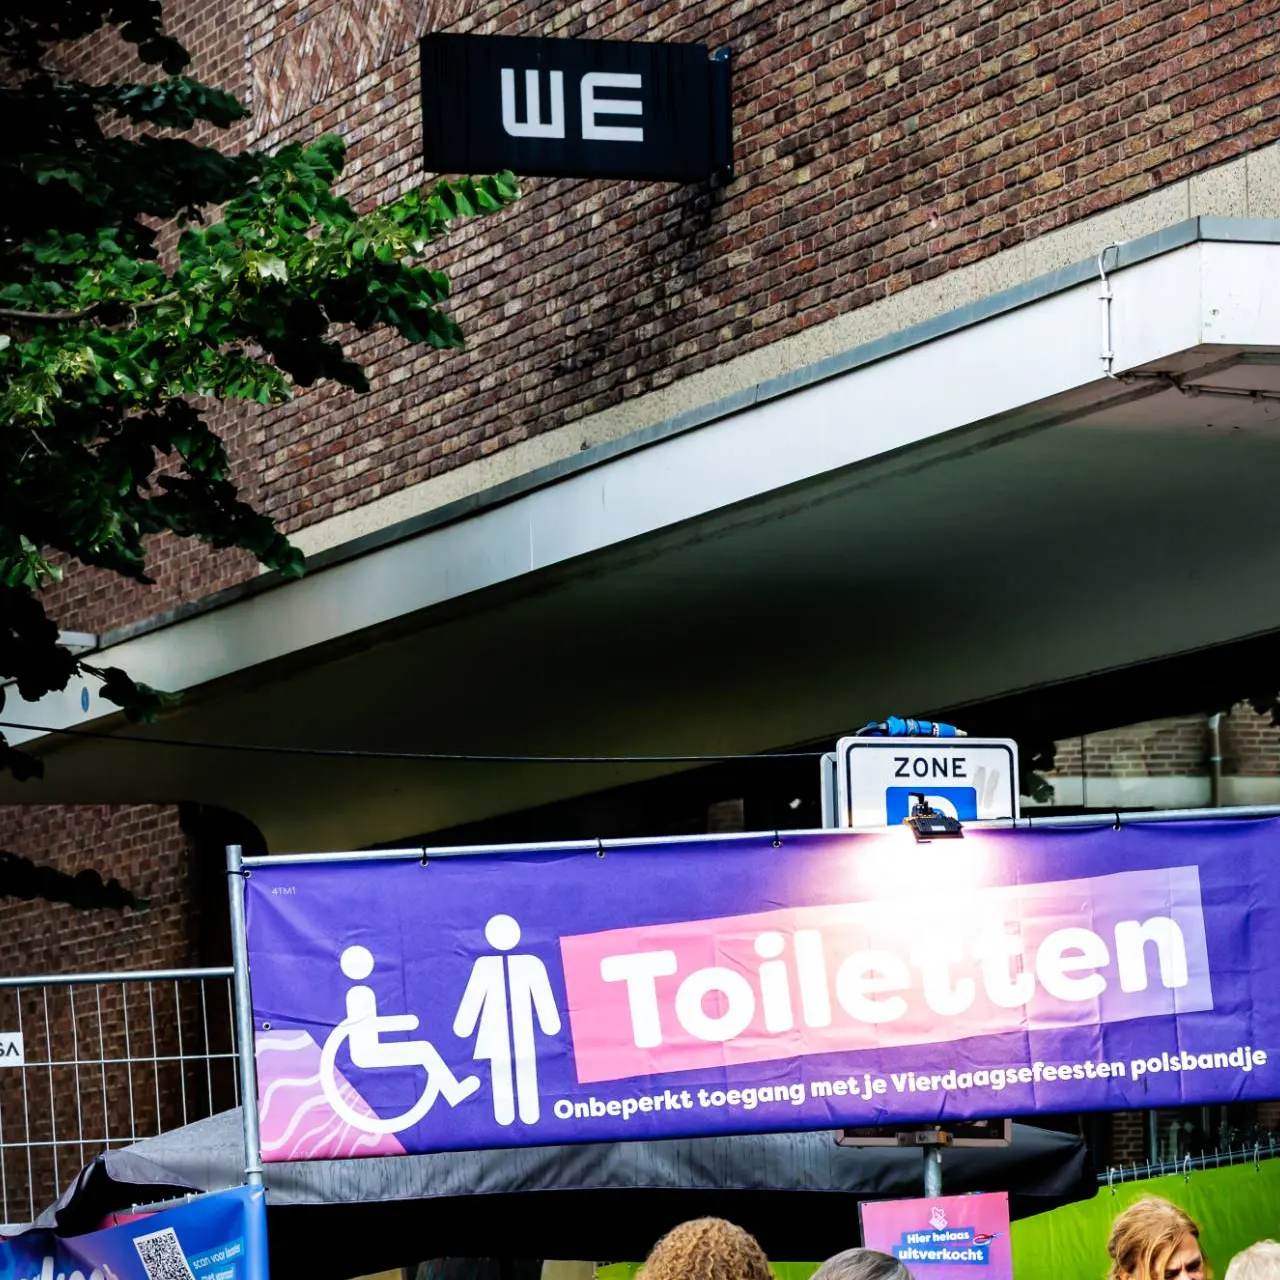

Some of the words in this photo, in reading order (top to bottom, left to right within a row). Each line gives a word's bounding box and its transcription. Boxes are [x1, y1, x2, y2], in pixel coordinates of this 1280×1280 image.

[501, 68, 644, 142] WE
[894, 757, 967, 778] ZONE
[601, 912, 1189, 1049] Toiletten
[554, 1090, 694, 1120] Onbeperkt
[697, 1082, 806, 1112] toegang
[811, 1077, 859, 1098] met
[859, 1074, 888, 1101] je
[891, 1059, 1126, 1093] Vierdaagsefeesten
[1131, 1047, 1268, 1080] polsbandje
[898, 1247, 984, 1261] uitverkocht
[906, 1233, 932, 1244] Hier
[932, 1231, 970, 1242] helaas
